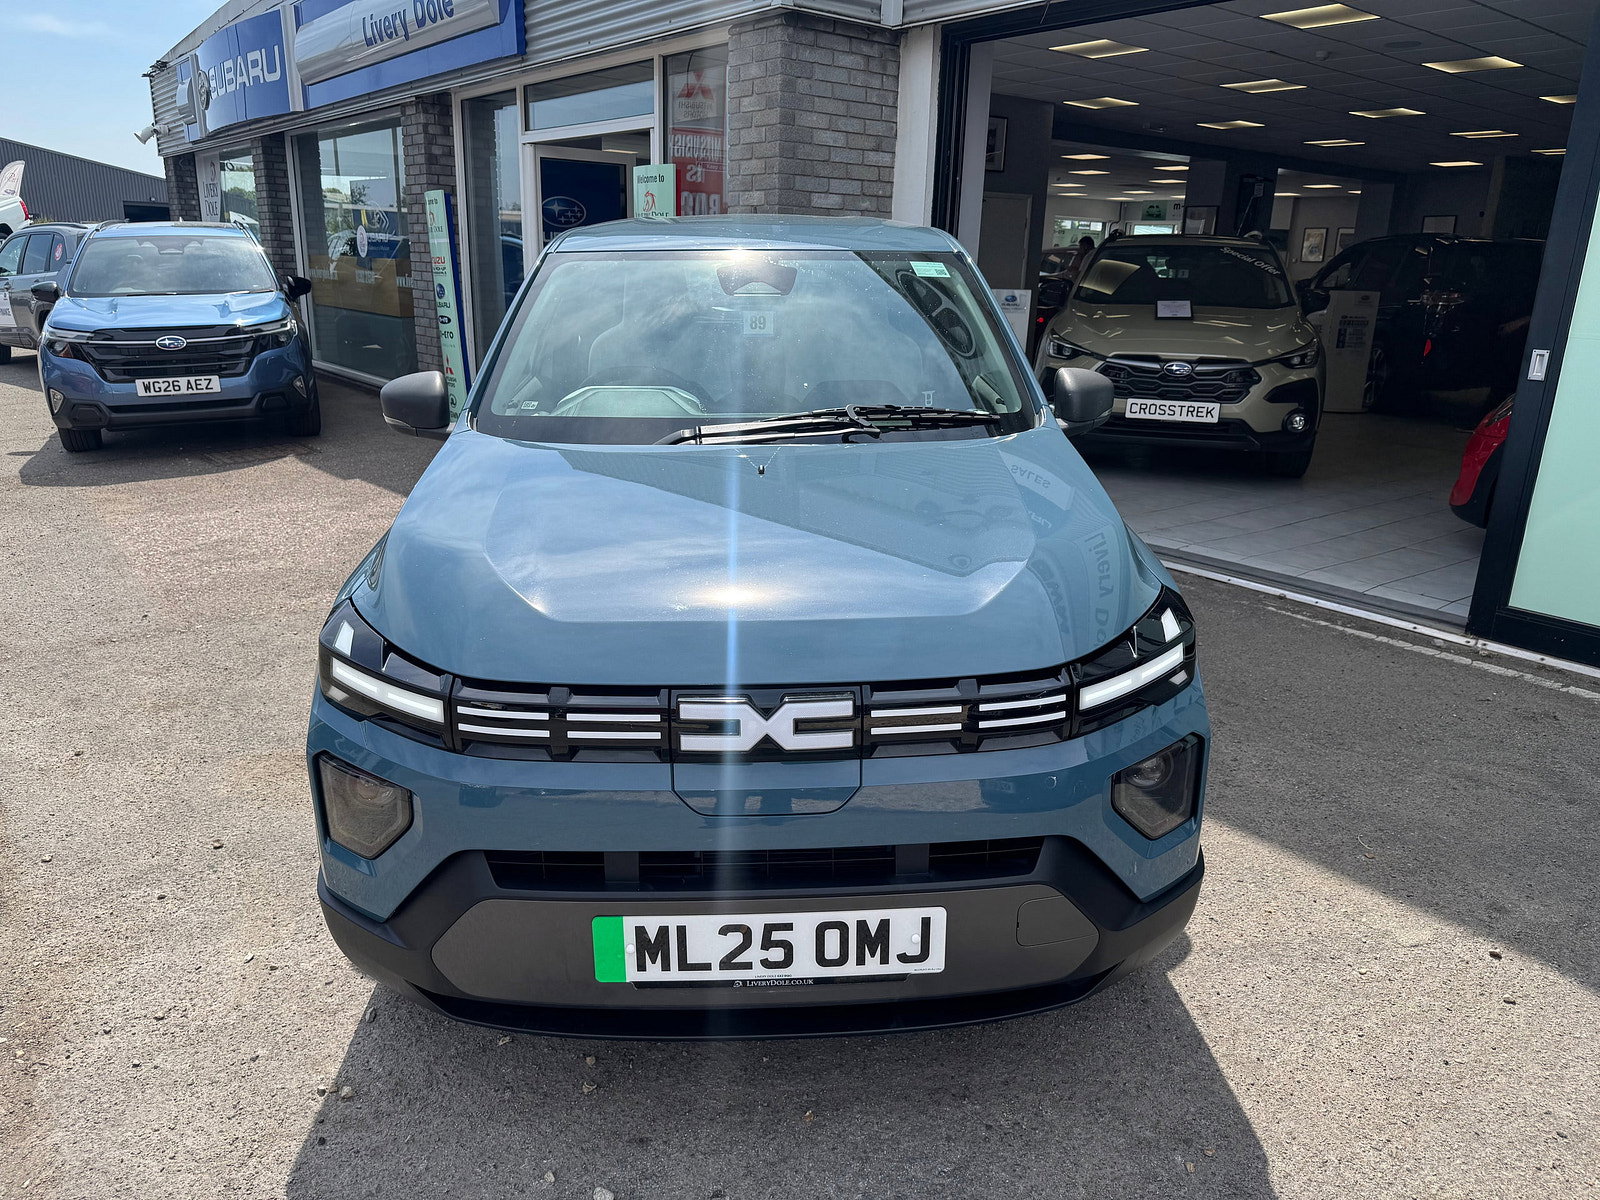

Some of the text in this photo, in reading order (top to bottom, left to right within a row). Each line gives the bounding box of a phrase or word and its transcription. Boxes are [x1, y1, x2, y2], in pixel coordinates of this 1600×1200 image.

[363, 0, 455, 47] Livery Dole
[208, 45, 281, 100] SUBARU
[659, 173, 665, 183] to
[1220, 246, 1281, 276] Special Offer
[750, 315, 767, 330] 89
[142, 378, 214, 394] WG26 AEZ
[1129, 402, 1215, 418] CROSSTREK
[634, 916, 932, 973] ML25 OMJ
